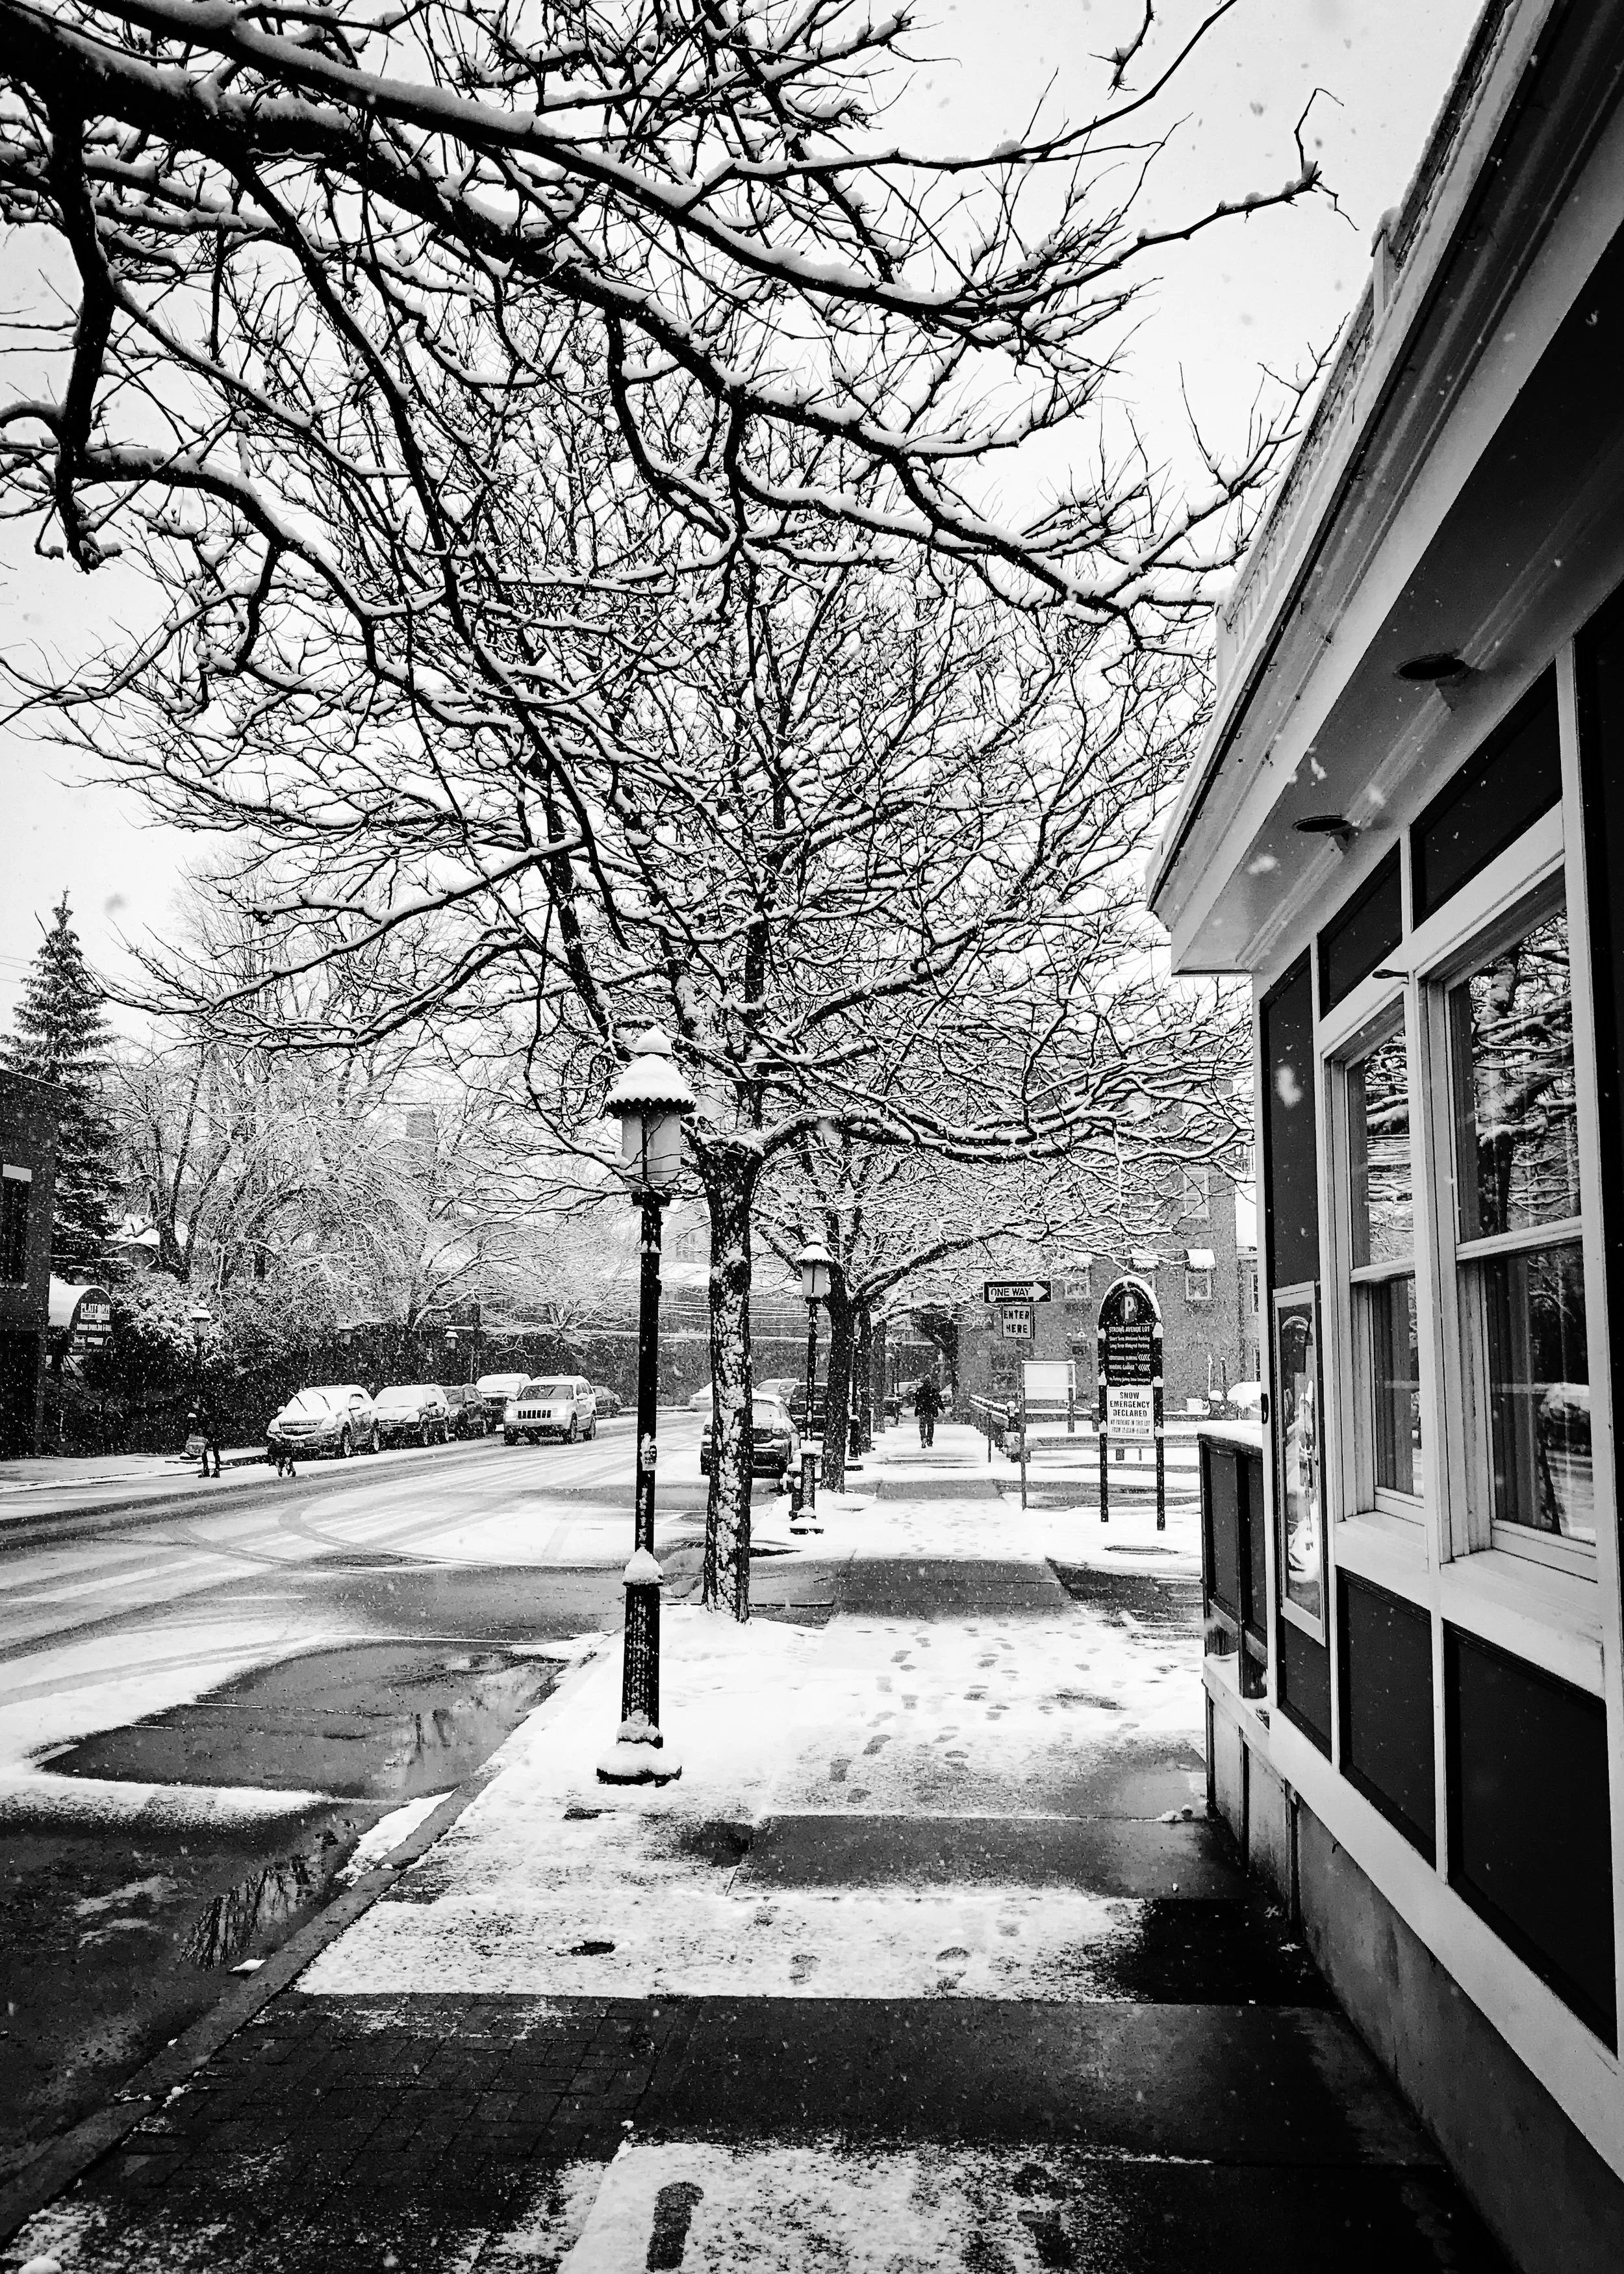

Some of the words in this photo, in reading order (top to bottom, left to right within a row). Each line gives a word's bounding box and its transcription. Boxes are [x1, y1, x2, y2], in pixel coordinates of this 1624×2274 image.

[991, 1288, 1009, 1296] ONE
[1012, 1287, 1030, 1296] WAY
[81, 1303, 110, 1314] PLATFORM
[1124, 1296, 1135, 1320] P
[1003, 1310, 1030, 1320] ENTER
[1006, 1324, 1028, 1333] HERE
[1110, 1400, 1150, 1409] EMERGENCY
